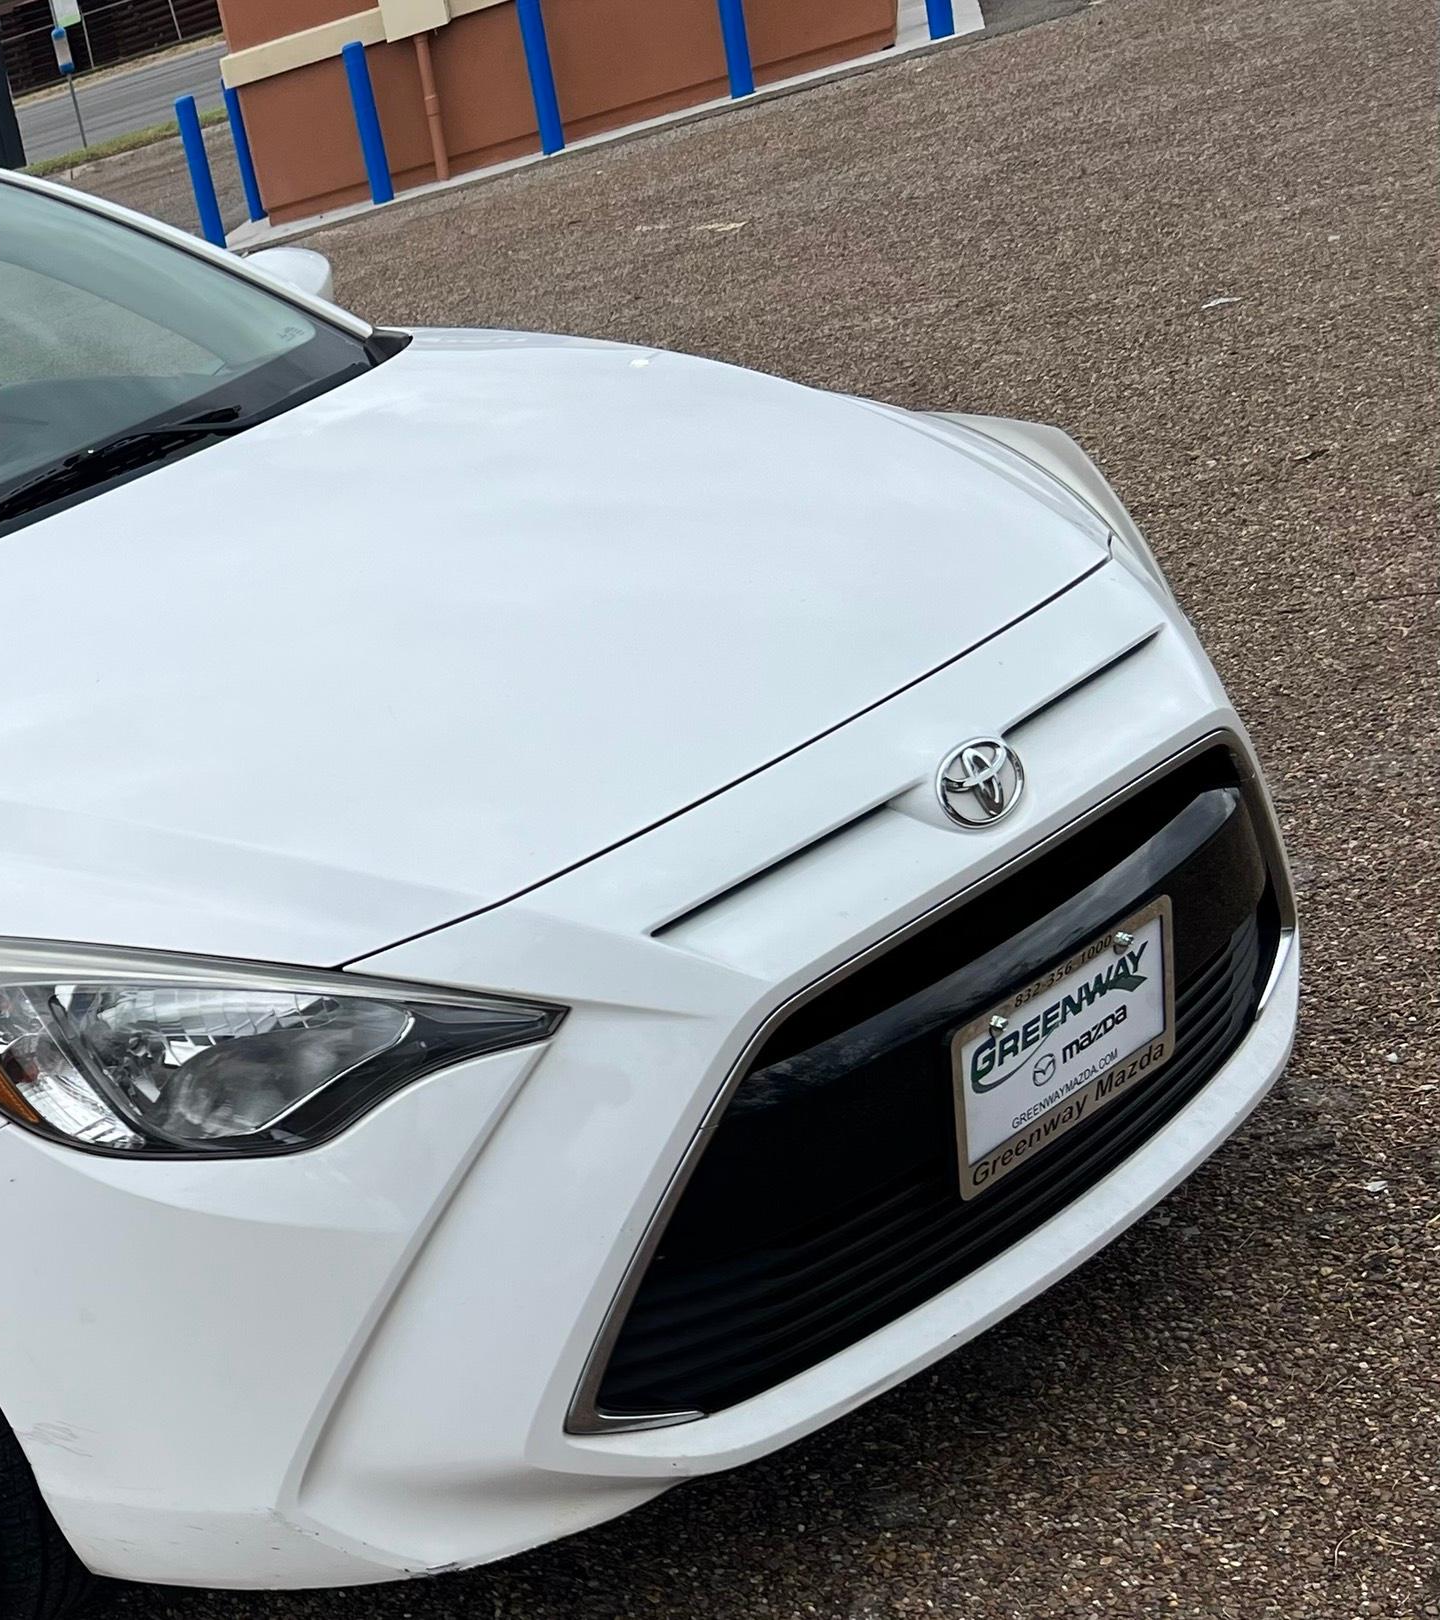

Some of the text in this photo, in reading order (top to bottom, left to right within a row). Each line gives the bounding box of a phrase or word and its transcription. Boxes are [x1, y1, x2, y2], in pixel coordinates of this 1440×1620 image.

[971, 940, 1148, 1093] GREENWAY
[972, 1043, 1165, 1186] Greenway Mazda
[1011, 1048, 1118, 1129] GREENWAYMAZDA.COM
